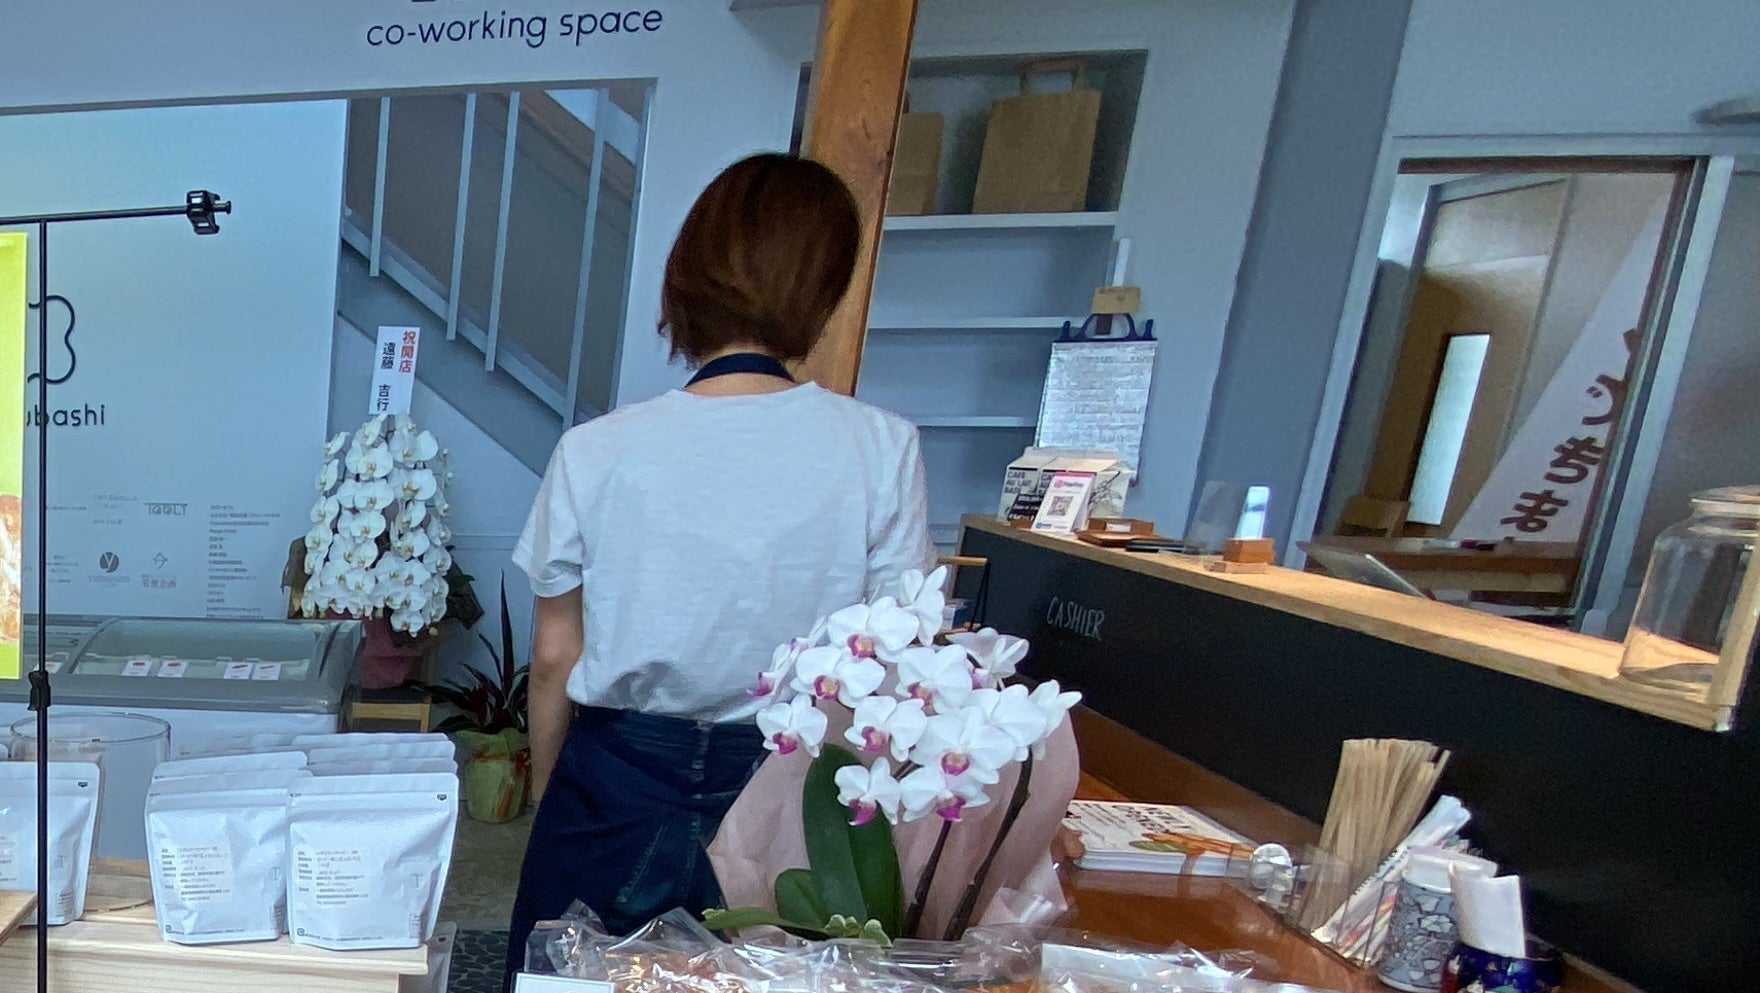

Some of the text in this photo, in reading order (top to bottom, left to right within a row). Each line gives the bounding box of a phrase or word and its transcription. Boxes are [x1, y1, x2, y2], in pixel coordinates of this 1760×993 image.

[366, 9, 663, 49] co-working space
[381, 342, 396, 370] 遠藤
[398, 330, 416, 373] 祝開店
[1047, 596, 1105, 641] CASHIER
